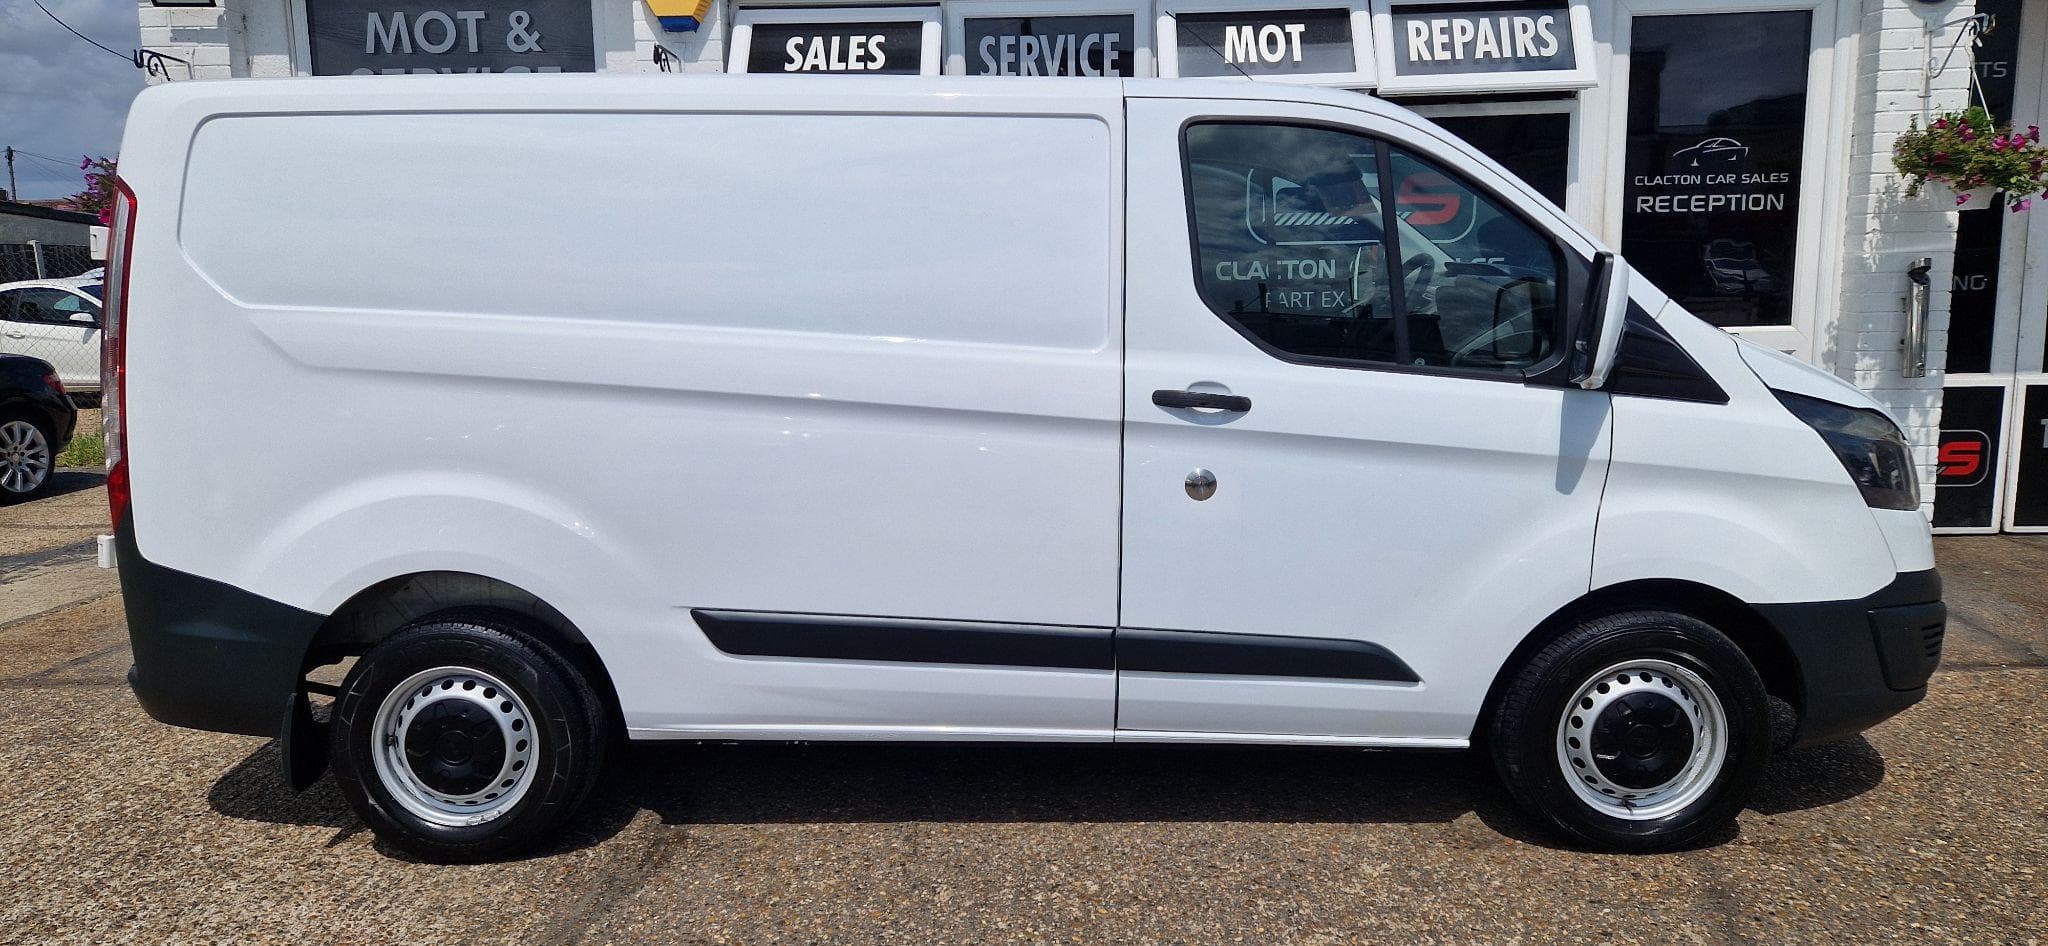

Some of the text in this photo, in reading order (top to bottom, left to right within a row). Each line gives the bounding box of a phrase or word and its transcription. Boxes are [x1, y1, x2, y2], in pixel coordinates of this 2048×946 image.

[365, 10, 544, 54] MOT &
[1224, 23, 1306, 64] MOT
[1407, 15, 1559, 62] REPAIRS
[783, 34, 886, 72] SALES
[979, 33, 1120, 77] SERVICE
[1634, 172, 1790, 186] CLACTON CAR SALES
[1636, 193, 1785, 213] RECEPTION
